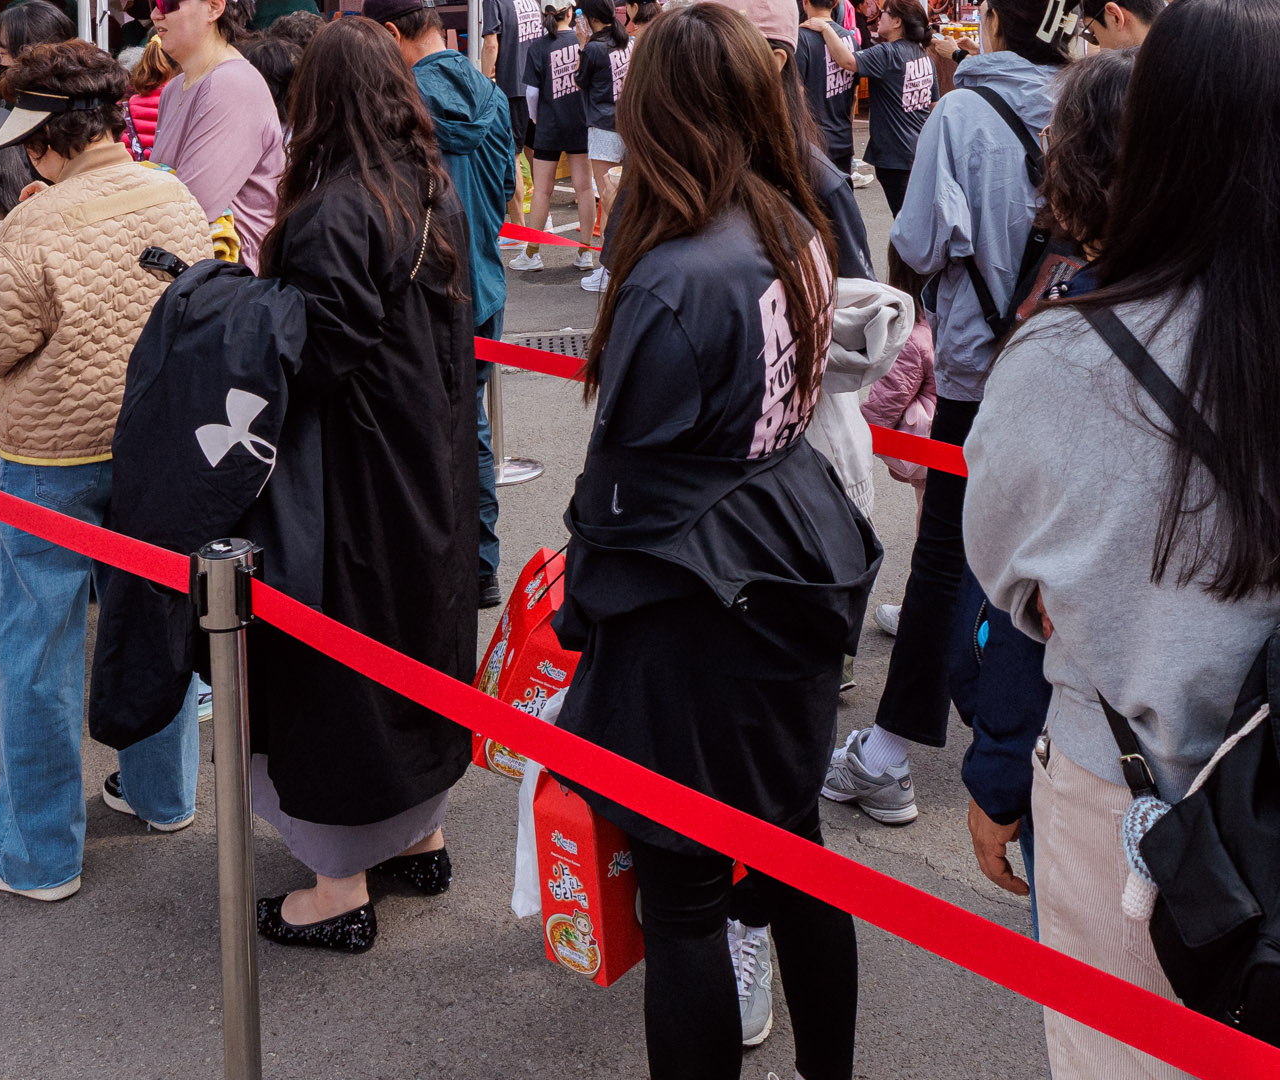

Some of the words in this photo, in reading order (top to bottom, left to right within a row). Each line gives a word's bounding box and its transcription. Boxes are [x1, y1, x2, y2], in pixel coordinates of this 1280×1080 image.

[518, 20, 542, 37] RACE
[554, 66, 570, 77] YOUR
[904, 56, 933, 81] RUN
